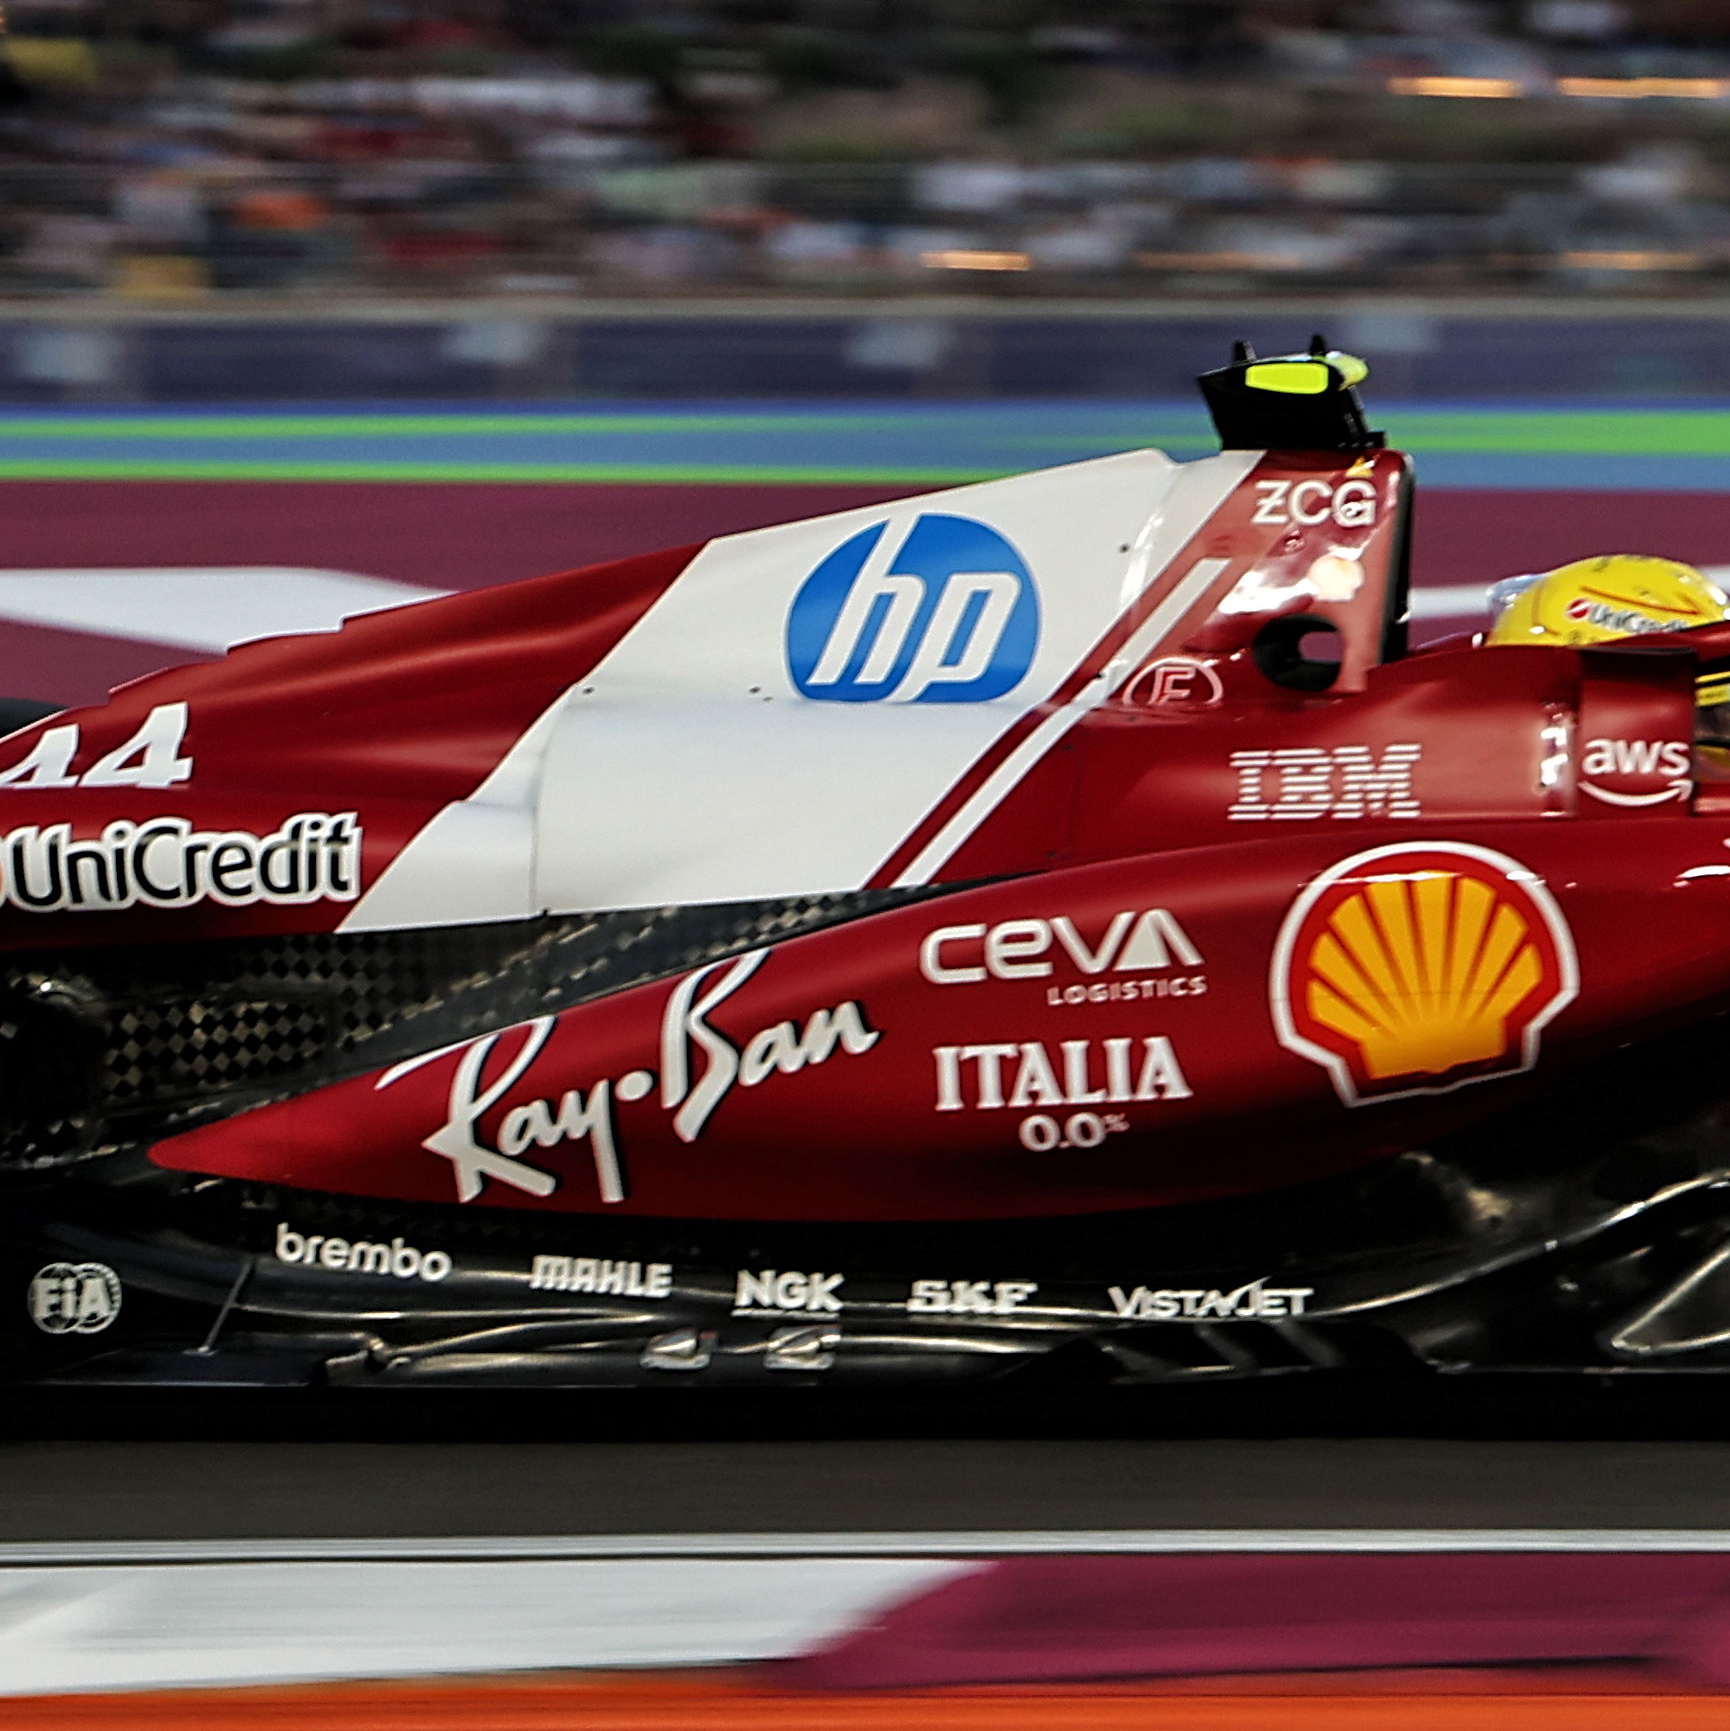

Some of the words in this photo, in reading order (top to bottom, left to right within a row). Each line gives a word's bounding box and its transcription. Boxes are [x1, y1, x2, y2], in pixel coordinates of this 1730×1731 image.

[1252, 479, 1377, 528] ZCG
[800, 515, 1030, 703] hp
[1229, 744, 1421, 821] IBM
[1582, 738, 1691, 778] aws
[5, 815, 357, 910] UniCredit
[1047, 975, 1207, 1006] LOGISTICS
[932, 1036, 1193, 1111] ITALIA
[276, 1222, 452, 1282] brembo
[529, 1255, 673, 1299] MAHLE
[734, 1270, 845, 1313] NGK
[907, 1280, 1038, 1314] SKF
